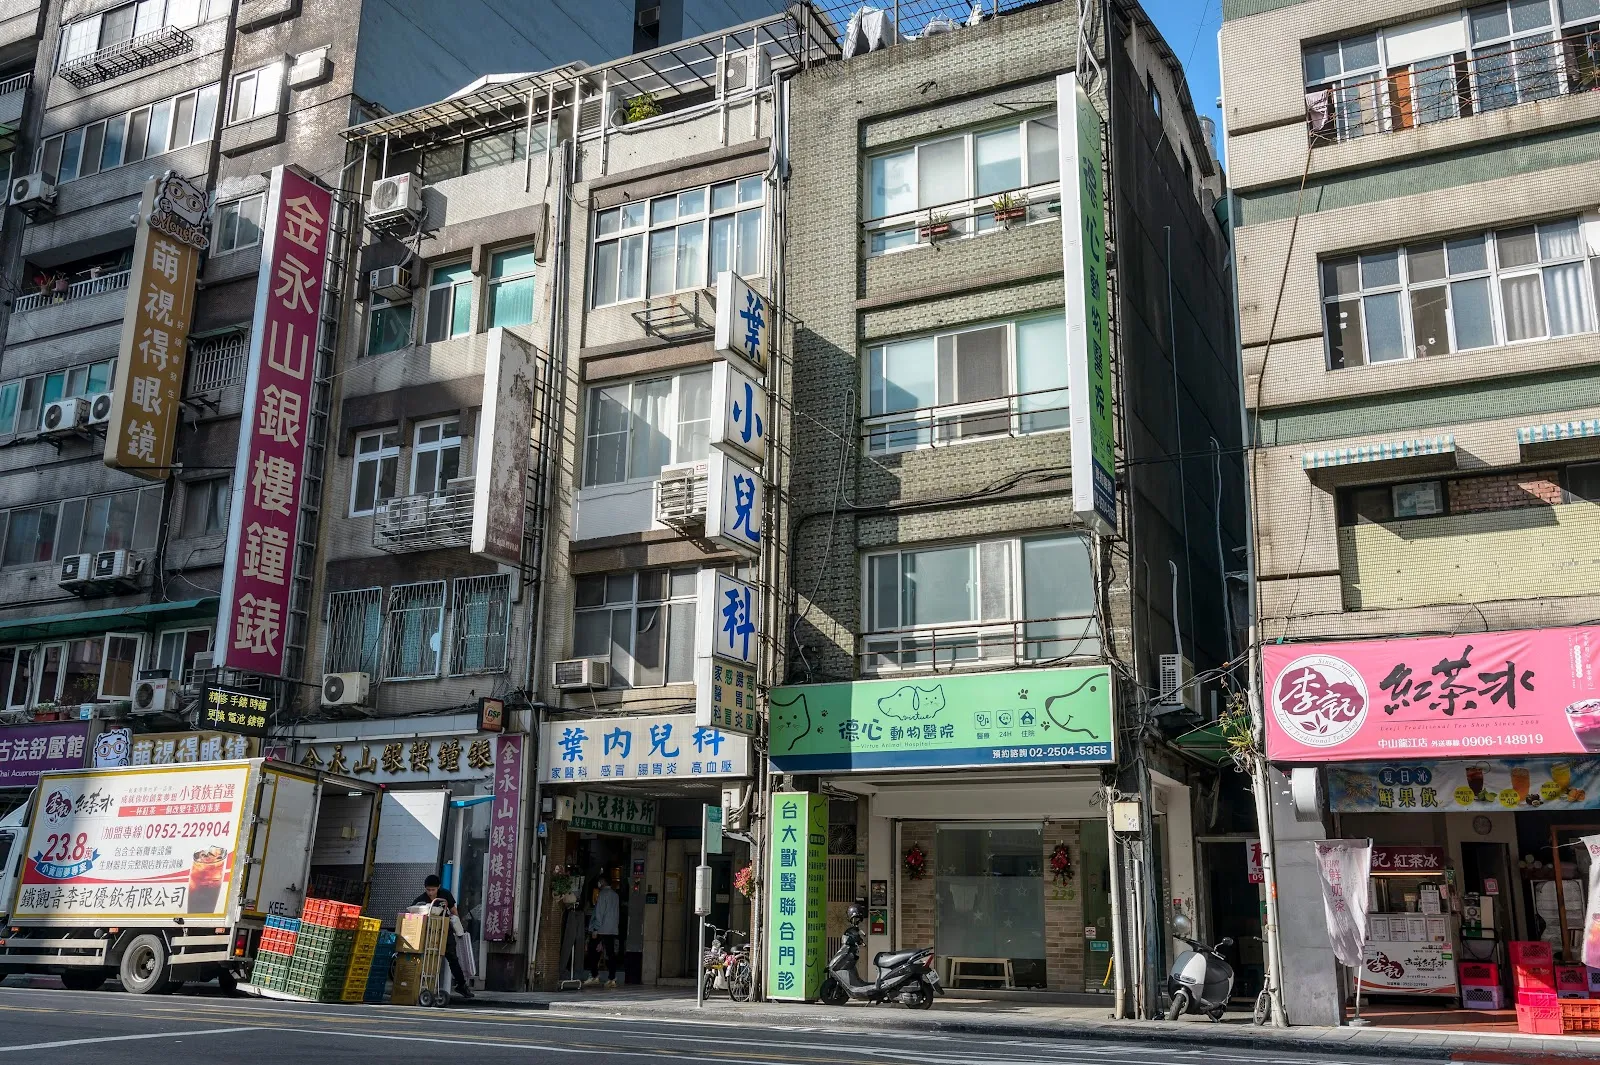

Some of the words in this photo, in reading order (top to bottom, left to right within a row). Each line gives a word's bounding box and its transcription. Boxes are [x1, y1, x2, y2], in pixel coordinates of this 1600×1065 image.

[151, 213, 207, 247] Monster
[127, 239, 182, 465] 萌視得眼鏡
[233, 194, 326, 658] 金永山銀樓鐘錶
[723, 288, 765, 662] 葉小兒科
[725, 669, 733, 726] 感冒
[735, 671, 744, 728] 腸胃炎
[746, 674, 754, 731] 高血壓
[228, 711, 245, 724] 電池
[247, 714, 266, 728] 錶帶
[839, 718, 883, 741] 德心
[890, 723, 954, 741] 動物醫院
[1293, 731, 1331, 744] Traditional
[1345, 721, 1358, 734] Shop
[1404, 723, 1450, 731] Traditional
[0, 735, 85, 762] 古法舒壓館
[132, 734, 248, 766] 萌視得眼鏡
[558, 723, 725, 763] 葉內兒科
[1029, 745, 1107, 758] 02-2504-5355
[1378, 737, 1428, 749] 中山龍江店
[1462, 733, 1543, 747] 0906-148919
[300, 738, 495, 775] 金永山銀樓鐘錶
[551, 766, 588, 779] 家醫科
[600, 764, 625, 777] 感冒
[638, 762, 677, 775] 腸胃炎
[691, 760, 732, 773] 高血壓
[180, 784, 235, 801] 小資族首選
[1378, 787, 1438, 808] 鮮果飲
[573, 792, 654, 824] 小兒科診所
[103, 825, 142, 840] 加盟專線
[146, 821, 230, 840] 0952-229904
[486, 740, 520, 934] 金永山銀樓鐘錶
[42, 832, 87, 861] 23.8
[1393, 853, 1438, 868] 紅茶冰
[19, 885, 187, 910] 鐵觀音李記優飲有限公司
[778, 801, 798, 991] 台大獸醫聯合門診
[1328, 868, 1346, 912] 鮮奶茶
